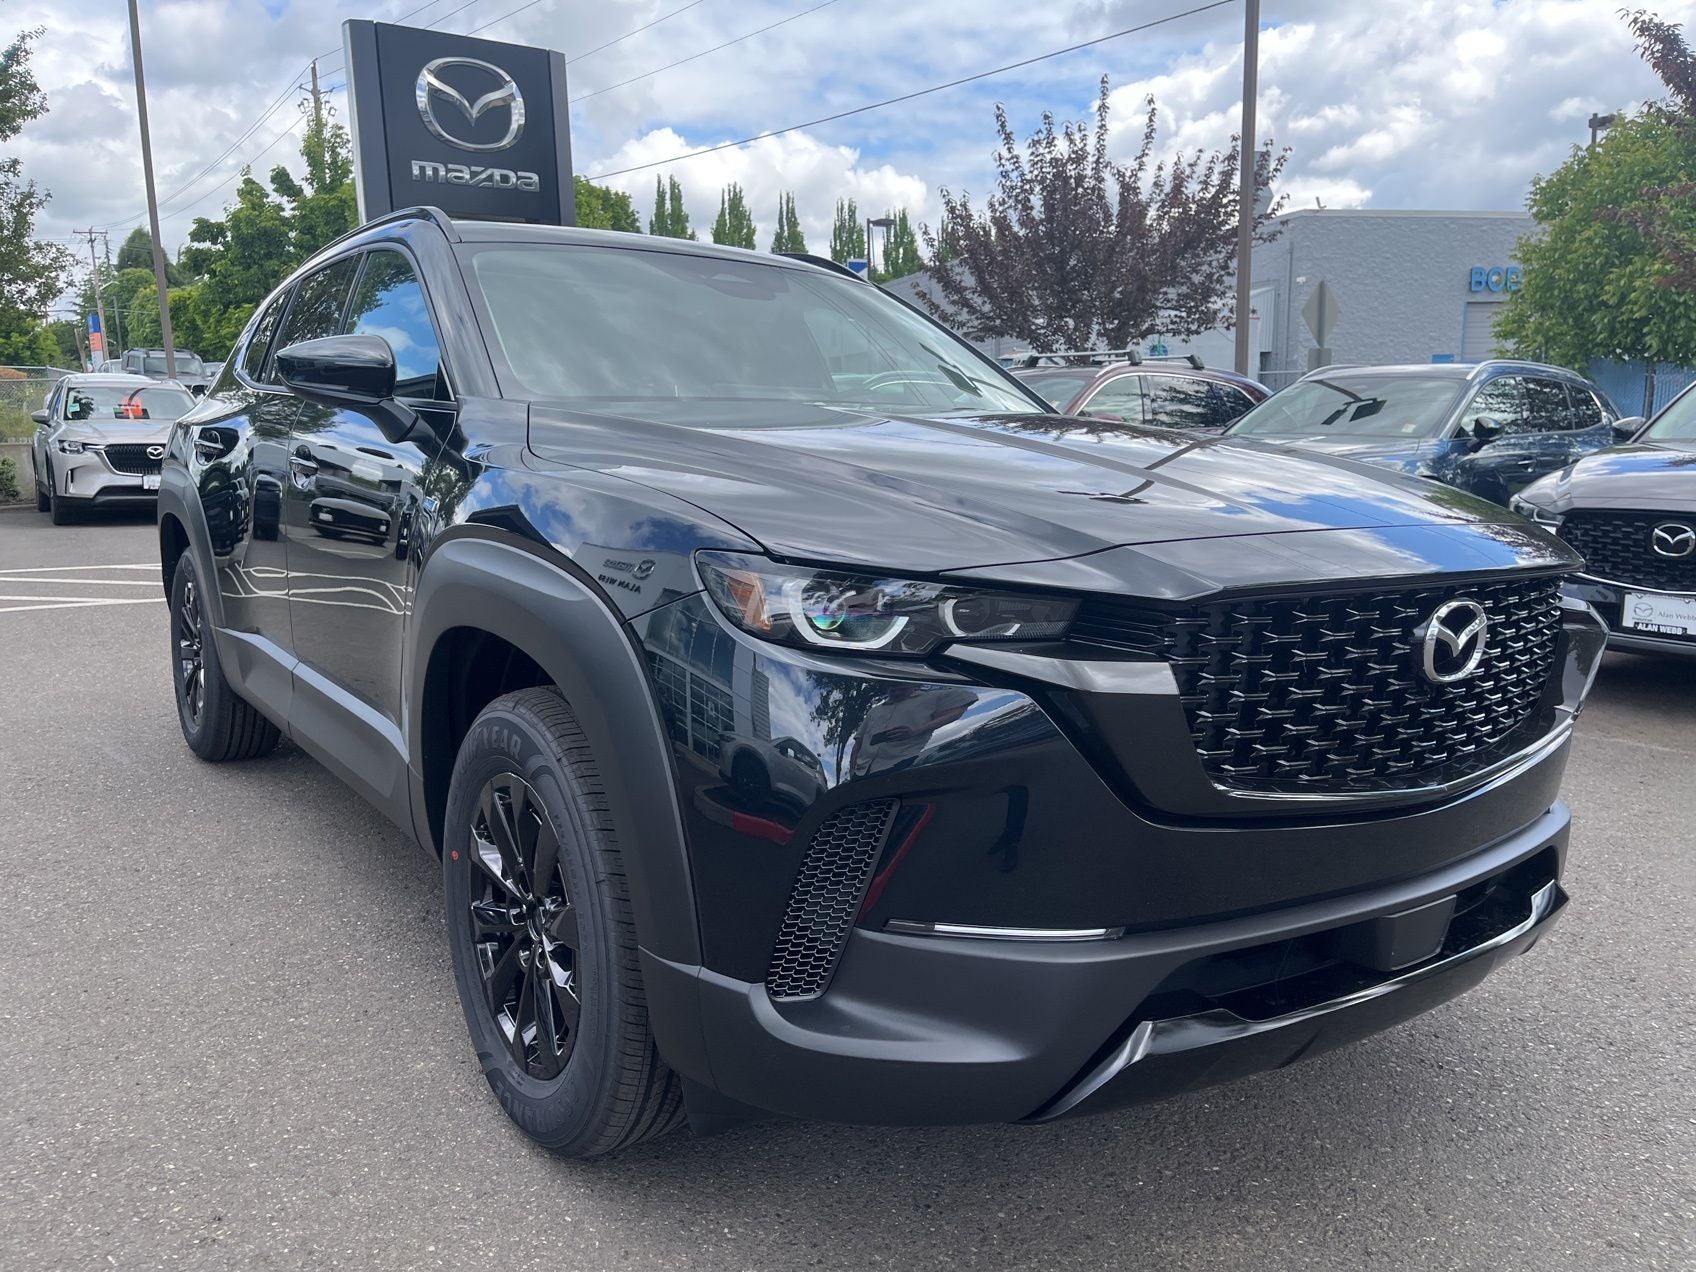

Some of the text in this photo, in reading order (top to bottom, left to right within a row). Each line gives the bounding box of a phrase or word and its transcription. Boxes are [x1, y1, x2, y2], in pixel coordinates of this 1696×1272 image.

[411, 160, 540, 192] mazda
[1637, 623, 1683, 635] ALAN WEBB
